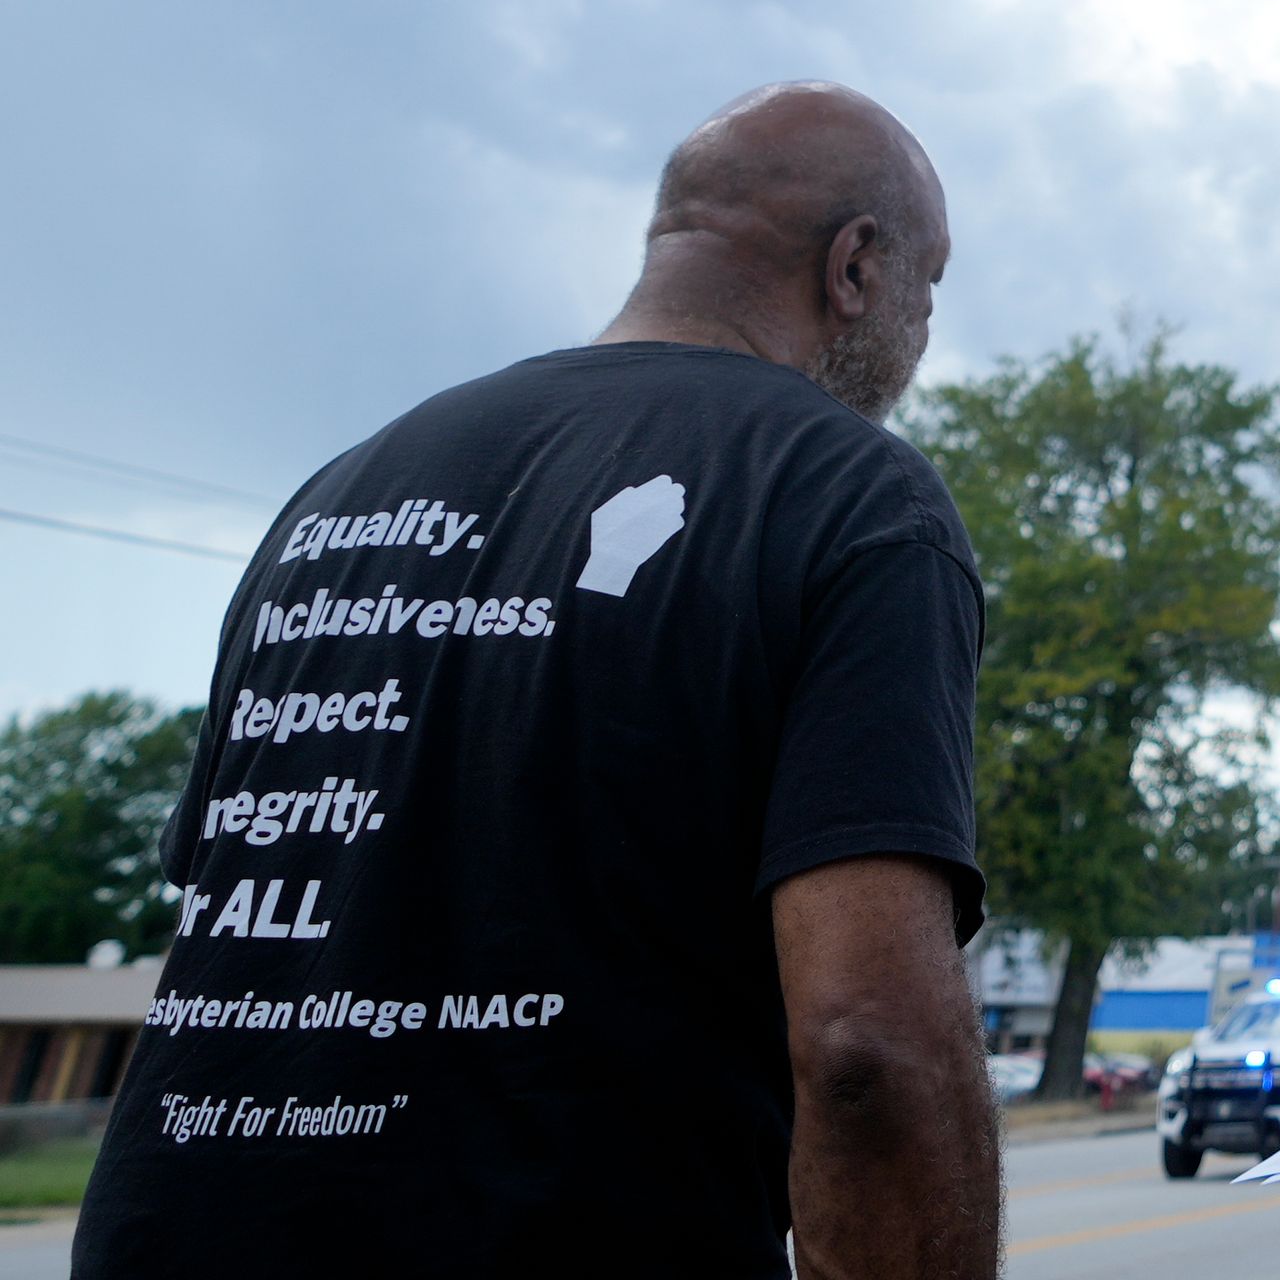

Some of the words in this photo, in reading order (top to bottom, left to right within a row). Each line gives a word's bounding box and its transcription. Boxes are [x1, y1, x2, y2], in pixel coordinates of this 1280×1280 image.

[279, 498, 485, 564] Equality.
[253, 584, 556, 653] Inclusiveness.
[209, 879, 332, 939] ALL.
[299, 991, 427, 1038] College
[437, 993, 564, 1030] NAACP
[227, 1096, 276, 1137] For
